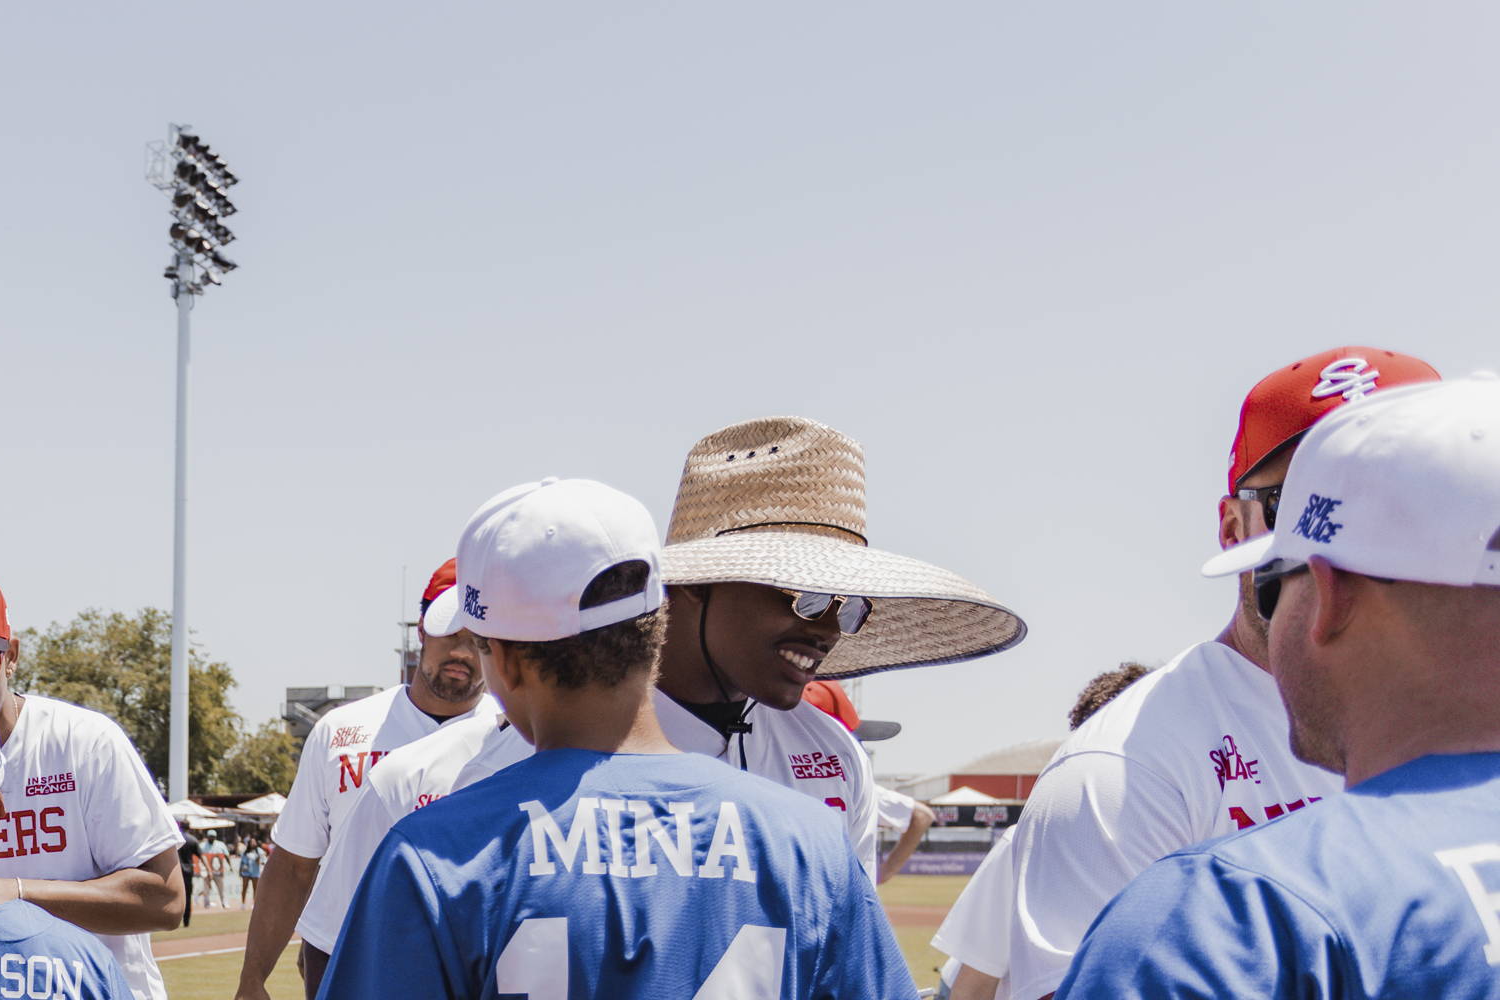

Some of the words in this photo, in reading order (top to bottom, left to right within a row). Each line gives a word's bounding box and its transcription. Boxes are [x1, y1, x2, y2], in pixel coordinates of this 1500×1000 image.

[27, 772, 73, 785] INSPIRE
[26, 781, 75, 796] CHANGE
[518, 797, 757, 884] MINA
